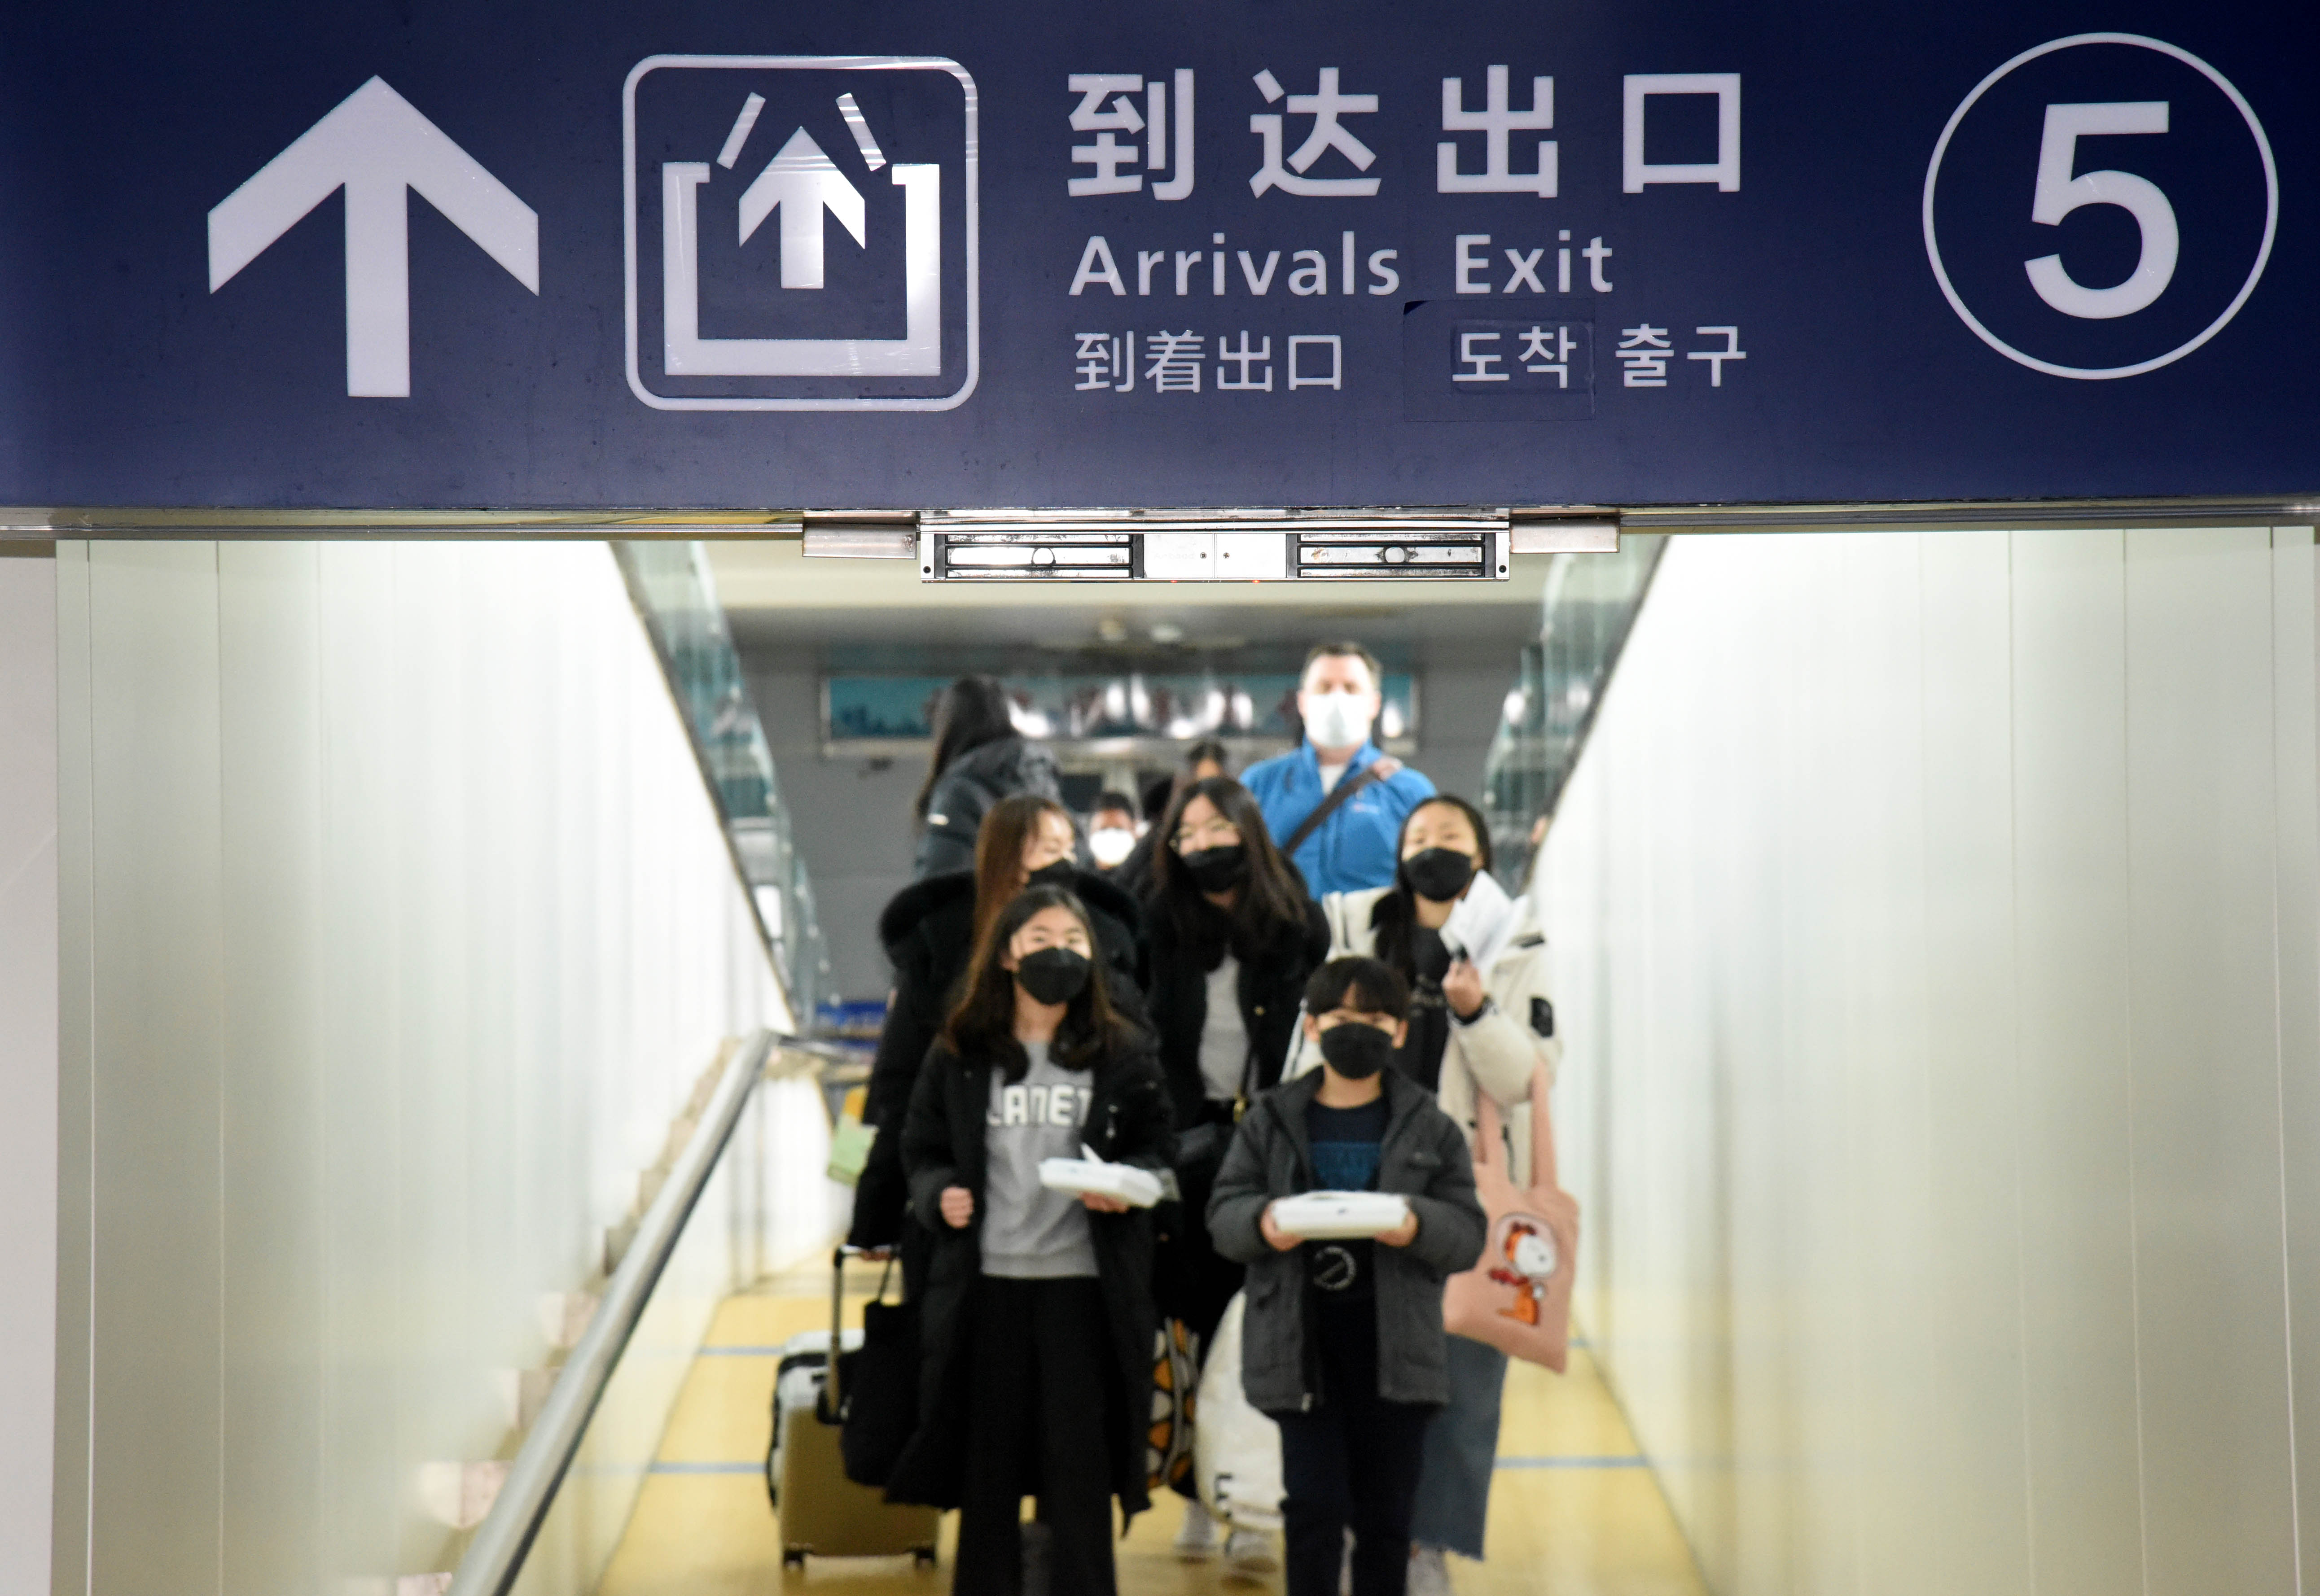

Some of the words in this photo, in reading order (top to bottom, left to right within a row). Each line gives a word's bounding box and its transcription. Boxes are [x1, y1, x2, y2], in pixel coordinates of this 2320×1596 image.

[1068, 66, 1741, 201] 到达出口
[2025, 102, 2179, 319] 5
[1069, 231, 1399, 296] Arrivals
[1455, 231, 1613, 294] Exit
[1074, 329, 1342, 393] 到着出口
[1452, 326, 1577, 389] 도착
[1616, 324, 1746, 387] 출구
